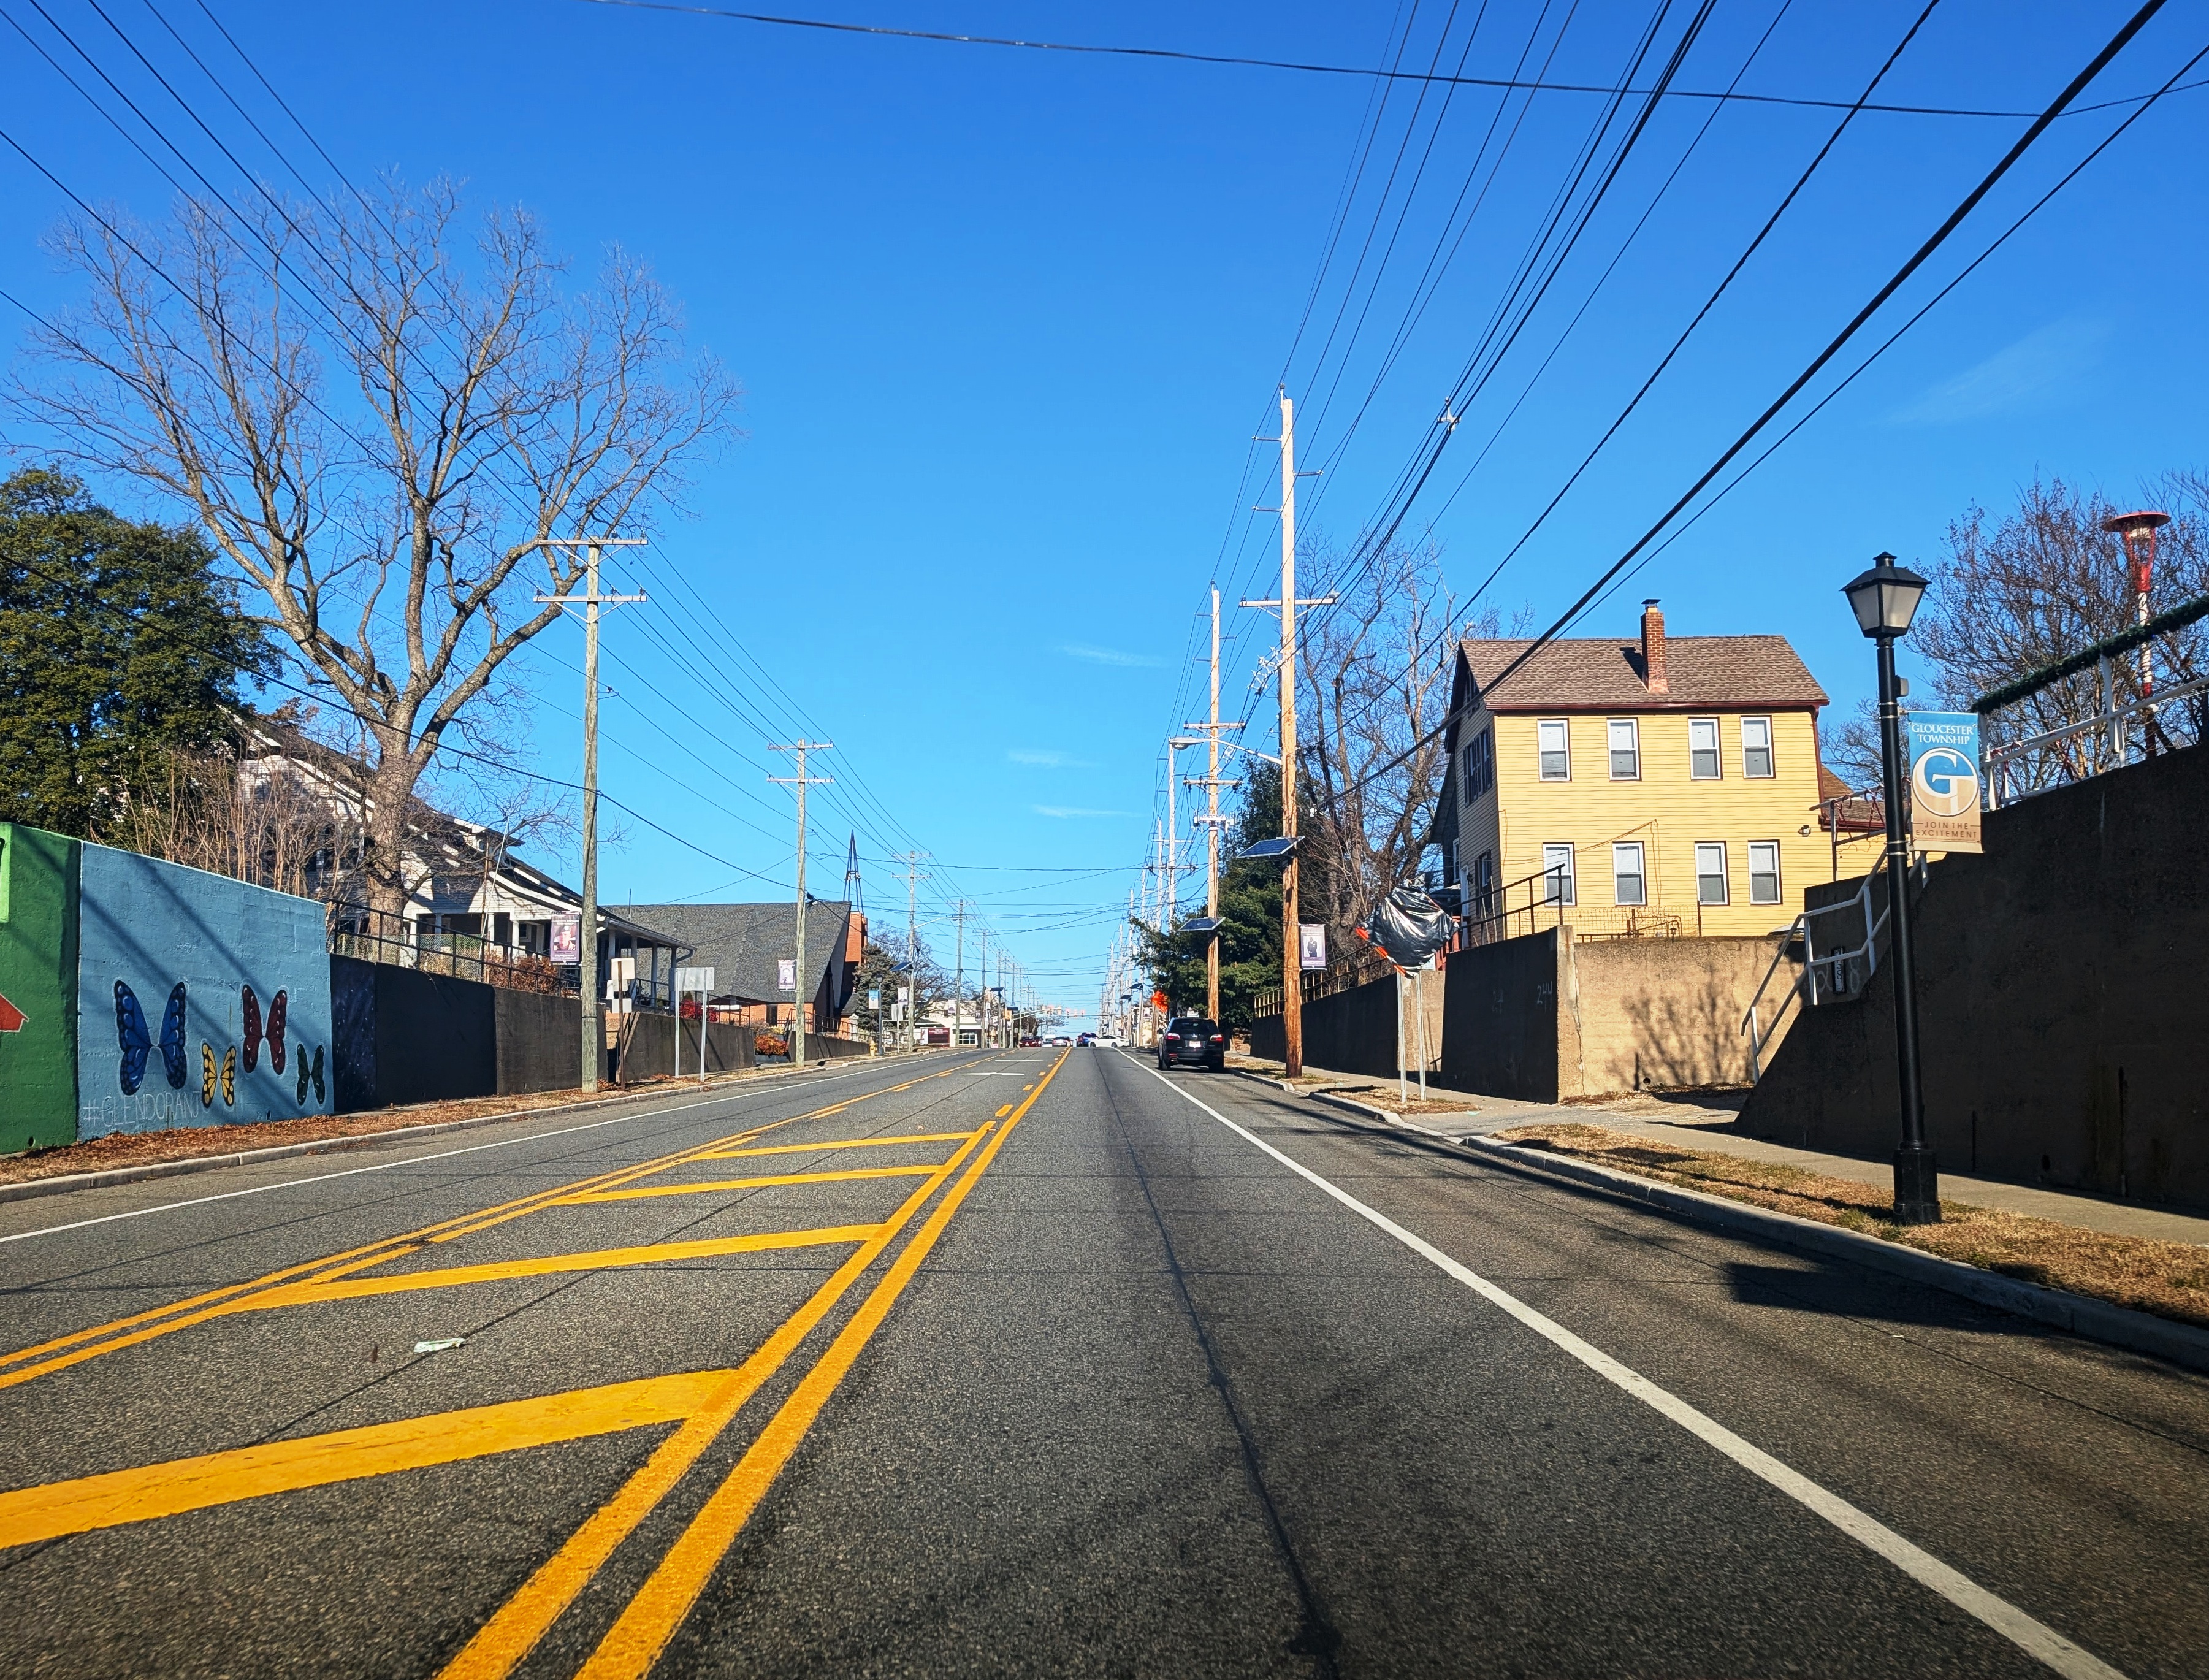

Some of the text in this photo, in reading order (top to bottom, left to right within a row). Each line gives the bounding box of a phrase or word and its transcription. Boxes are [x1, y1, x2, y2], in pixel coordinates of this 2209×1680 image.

[1912, 724, 1974, 735] GLOUCESTER
[1917, 734, 1970, 744] TOWNSHIP
[1916, 829, 1977, 838] EXCITEMENT
[1537, 980, 1552, 1014] 244
